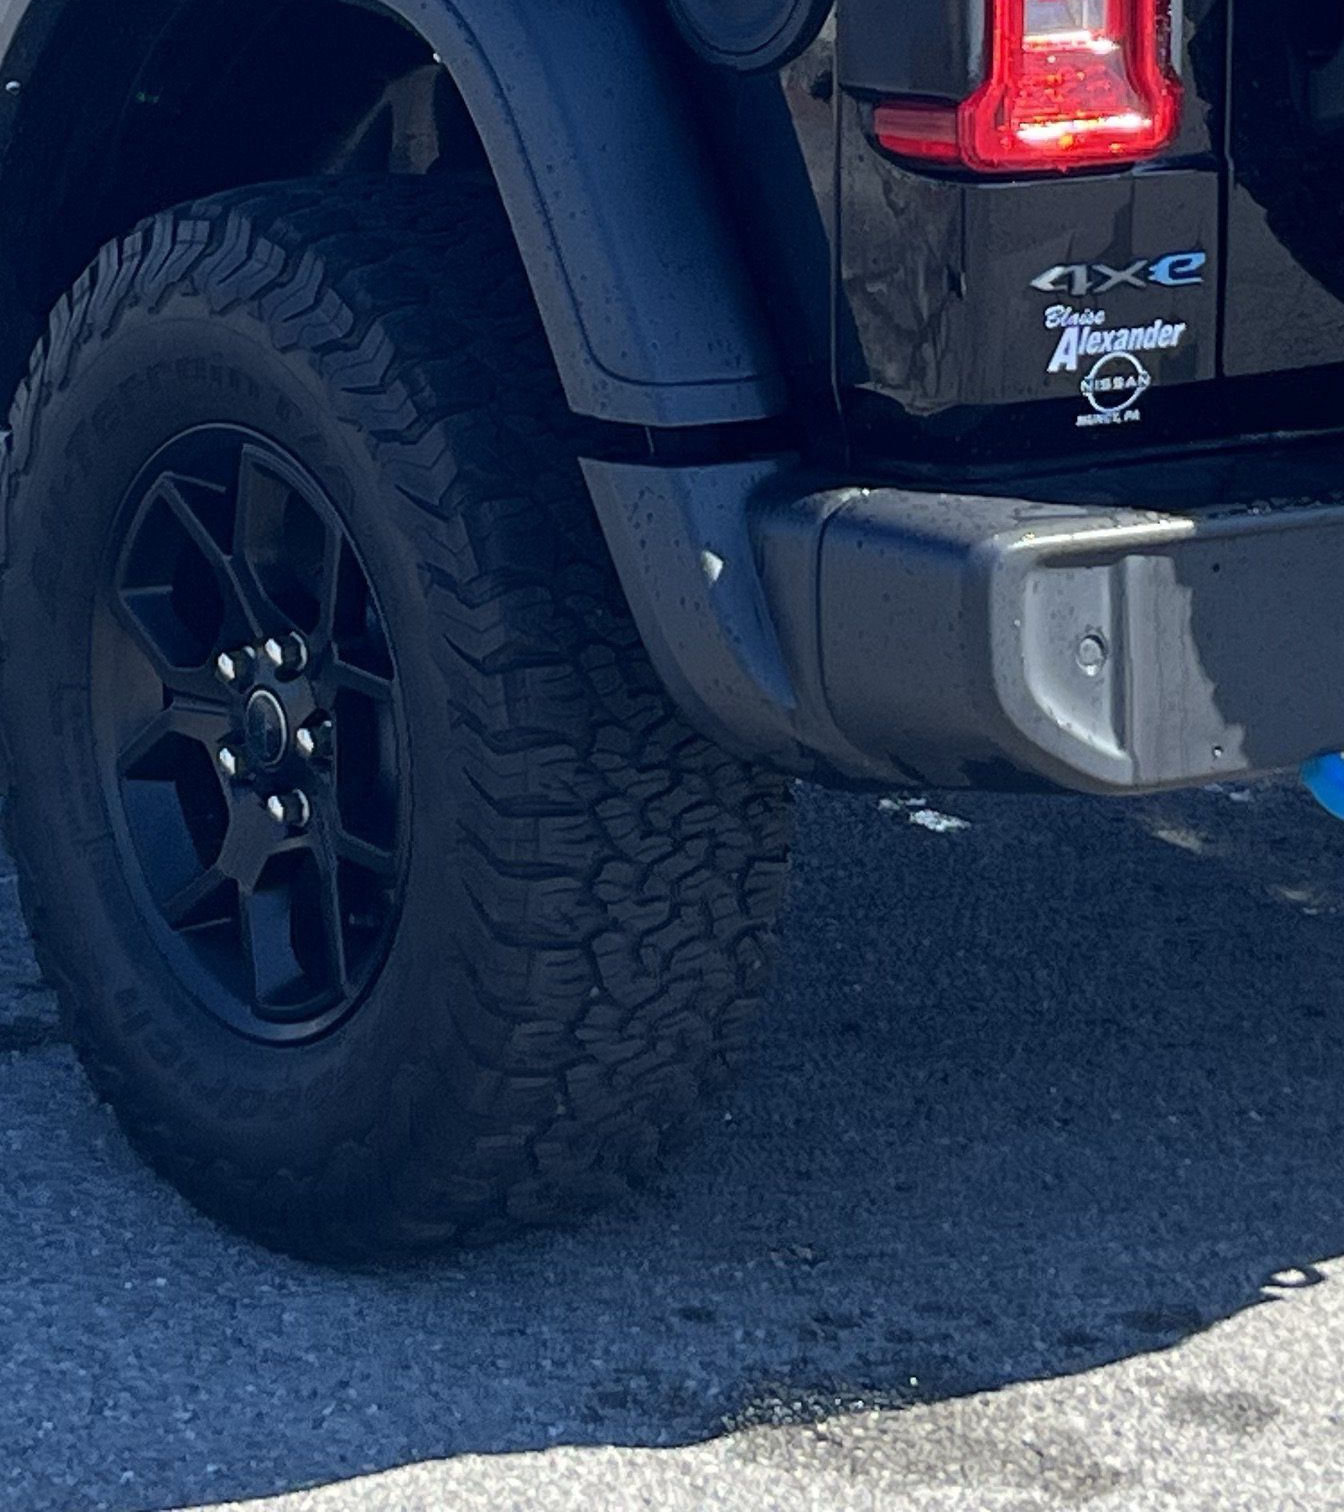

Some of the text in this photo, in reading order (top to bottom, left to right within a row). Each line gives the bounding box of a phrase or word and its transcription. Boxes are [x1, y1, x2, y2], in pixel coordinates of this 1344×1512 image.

[1044, 304, 1105, 329] Blaise
[1047, 319, 1186, 373] Alexander
[1081, 372, 1152, 394] NISSAN
